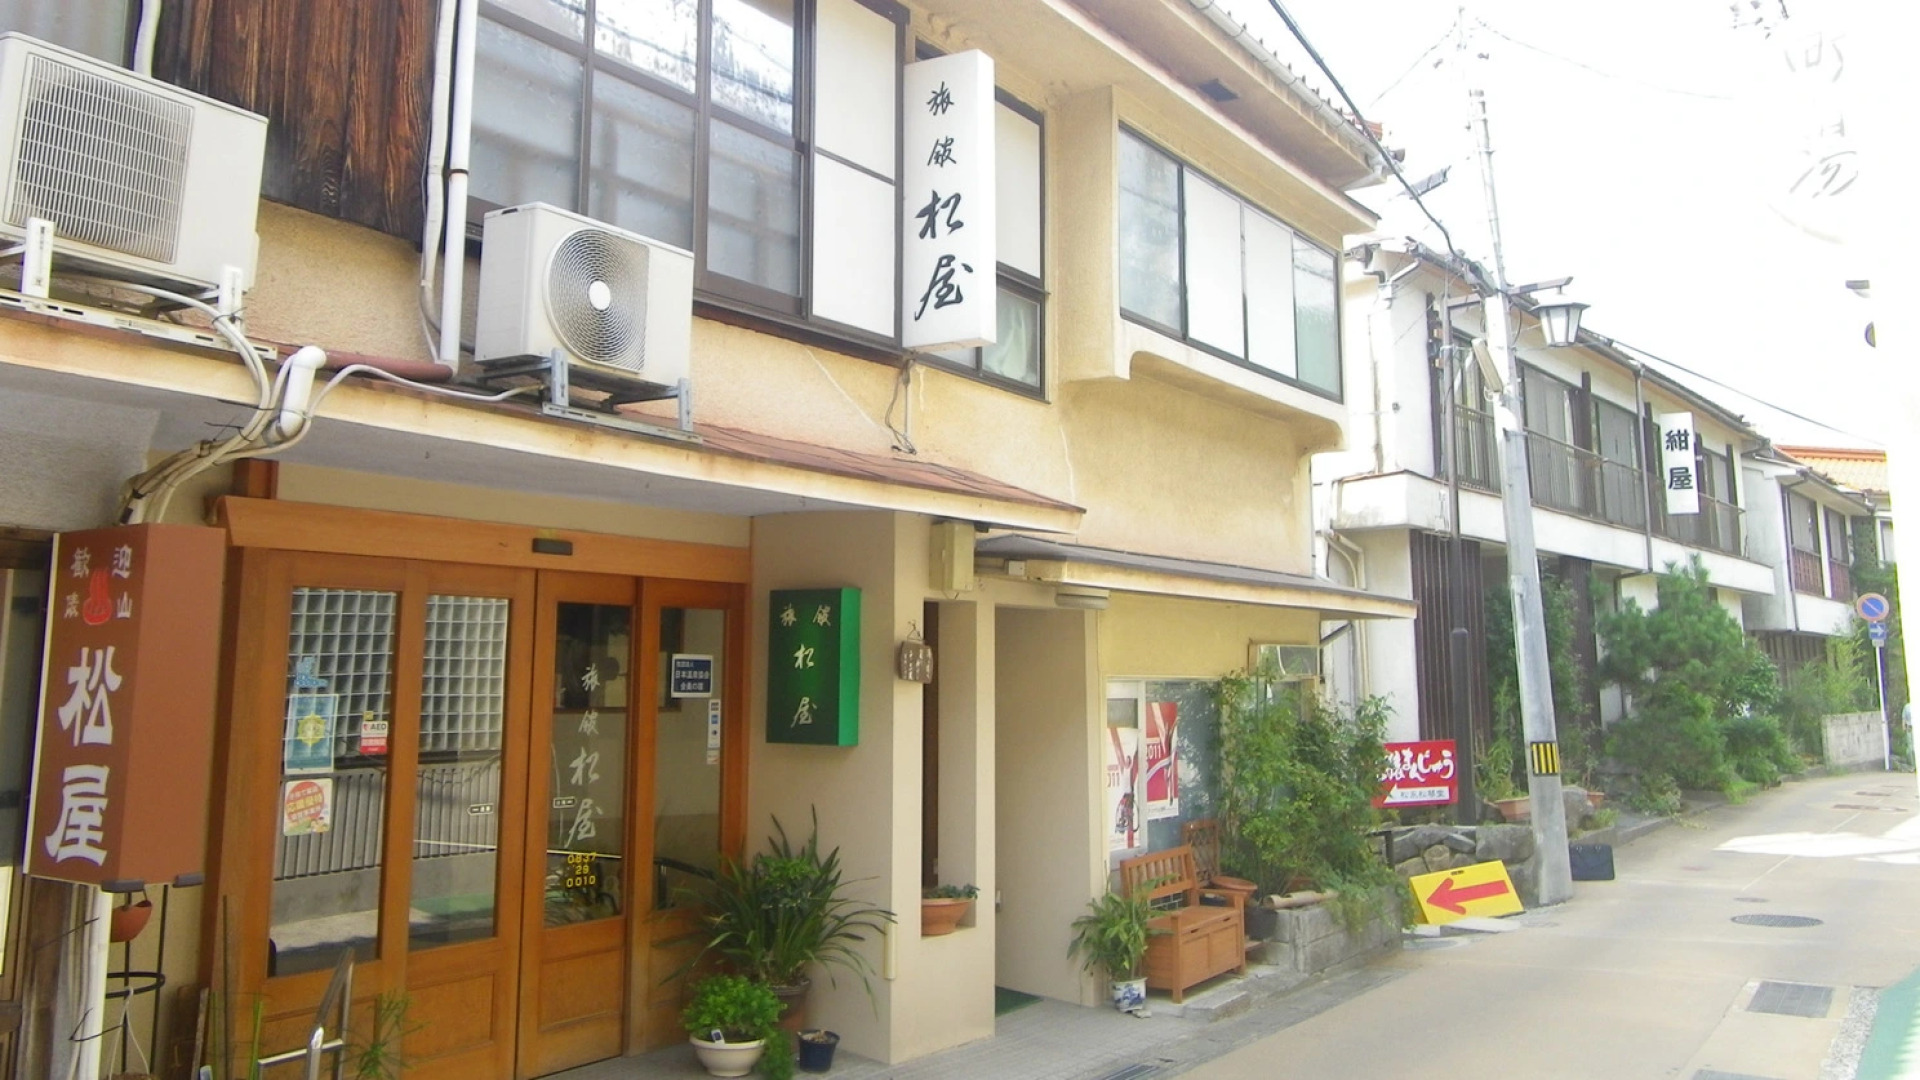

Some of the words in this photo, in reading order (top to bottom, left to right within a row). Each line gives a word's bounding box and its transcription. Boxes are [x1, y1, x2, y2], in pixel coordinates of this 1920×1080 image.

[1665, 429, 1694, 490] 紺屋
[790, 643, 817, 728] 松屋
[370, 723, 387, 731] AED
[45, 646, 122, 866] 松屋
[567, 852, 597, 864] 0837
[575, 865, 590, 875] 29
[566, 875, 596, 888] 0010
